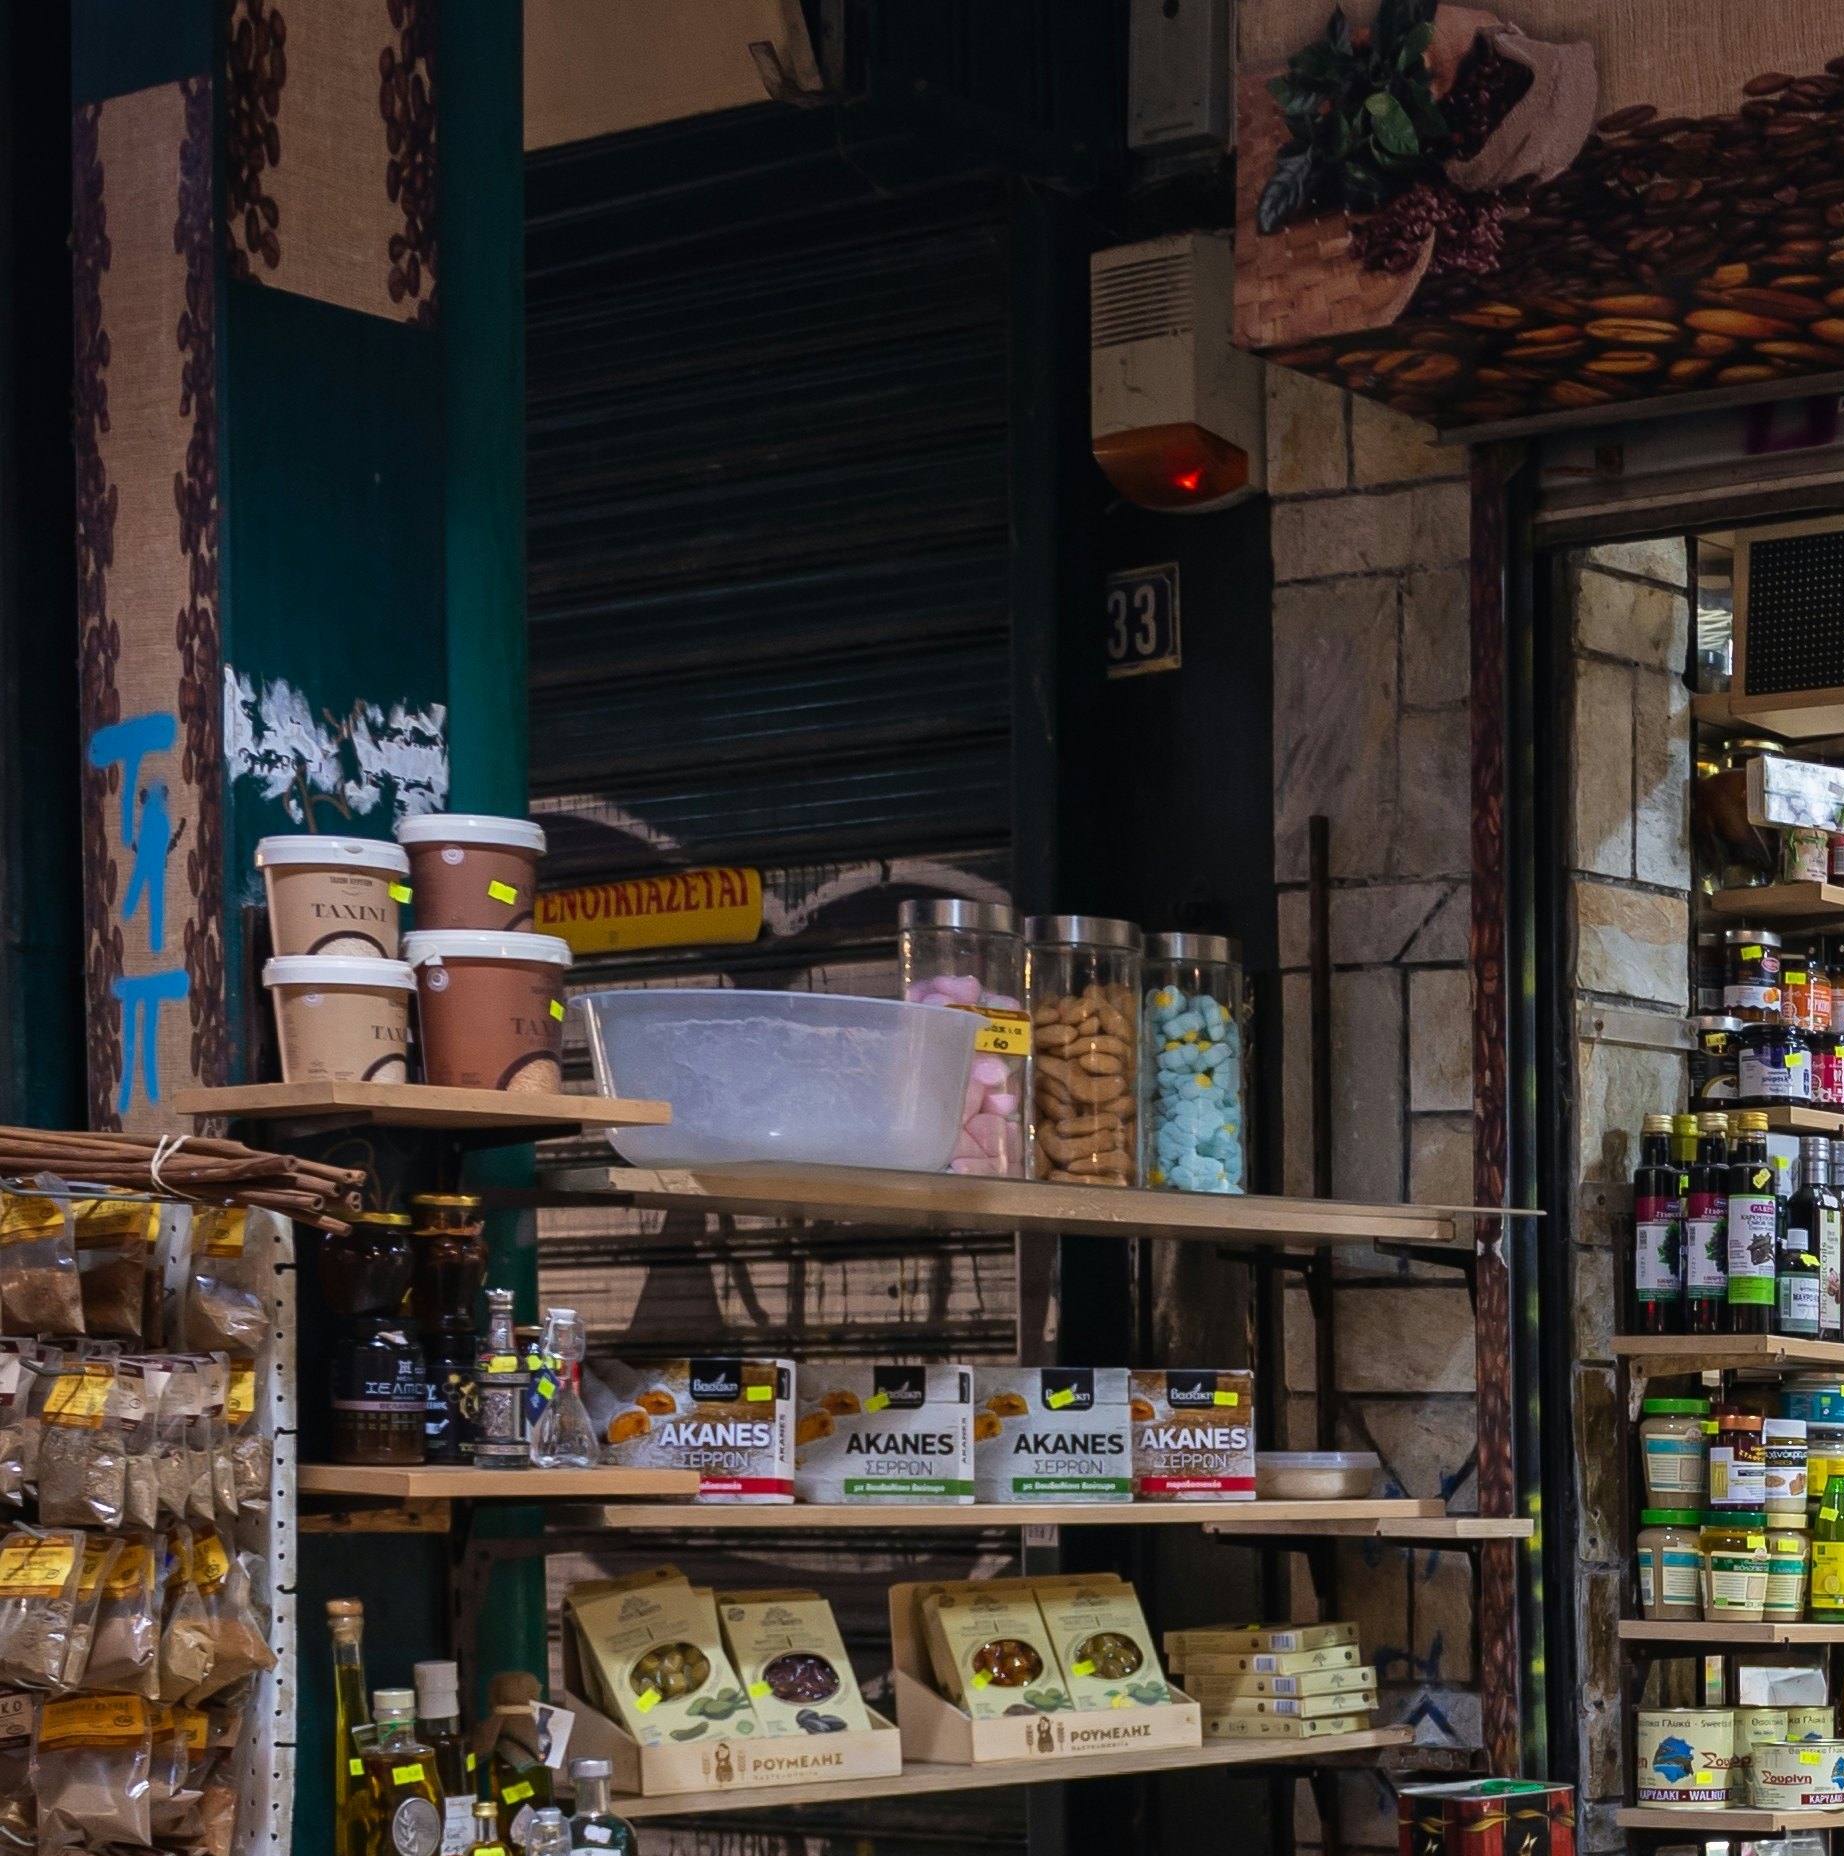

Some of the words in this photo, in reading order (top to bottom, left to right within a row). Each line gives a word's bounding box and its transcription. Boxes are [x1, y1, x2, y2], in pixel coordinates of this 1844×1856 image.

[311, 903, 387, 923] ΤΑΧΙΝΙ
[658, 1422, 771, 1447] AKANES
[845, 1433, 954, 1456] AKANES
[1012, 1433, 1125, 1456] AKANES
[1139, 1427, 1248, 1451] AKANES
[678, 1450, 752, 1469] ΣΕΡΡΩΝ
[864, 1458, 934, 1477] ΣΕΡΡΩΝ
[1033, 1458, 1104, 1476] ΣΕΡΡΩΝ
[1158, 1452, 1229, 1470] ΣΕΡΡΩΝ
[1070, 1723, 1152, 1743] ΡΟΥΜΕΛΗΣ
[752, 1750, 845, 1771] ΡΟΥΜΕΛΗΣ
